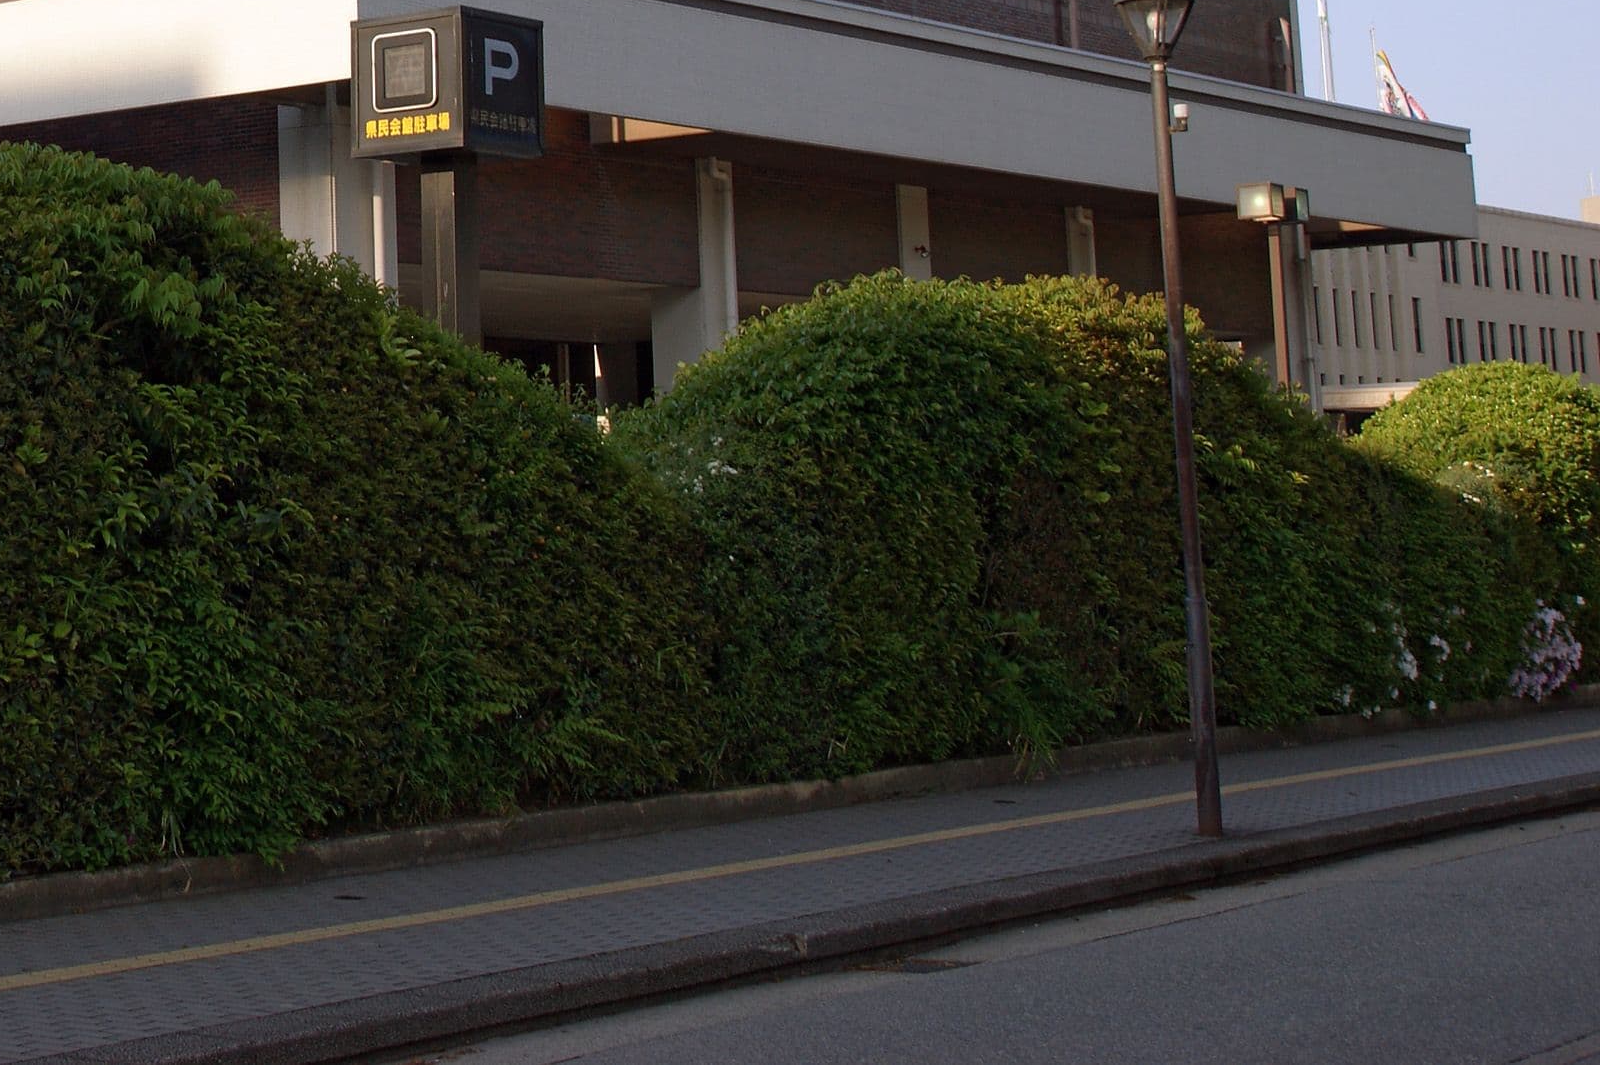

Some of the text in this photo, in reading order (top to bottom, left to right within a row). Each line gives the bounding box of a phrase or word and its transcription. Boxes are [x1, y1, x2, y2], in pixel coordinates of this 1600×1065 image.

[484, 38, 519, 95] P
[366, 112, 450, 139] 県民会館駐車場
